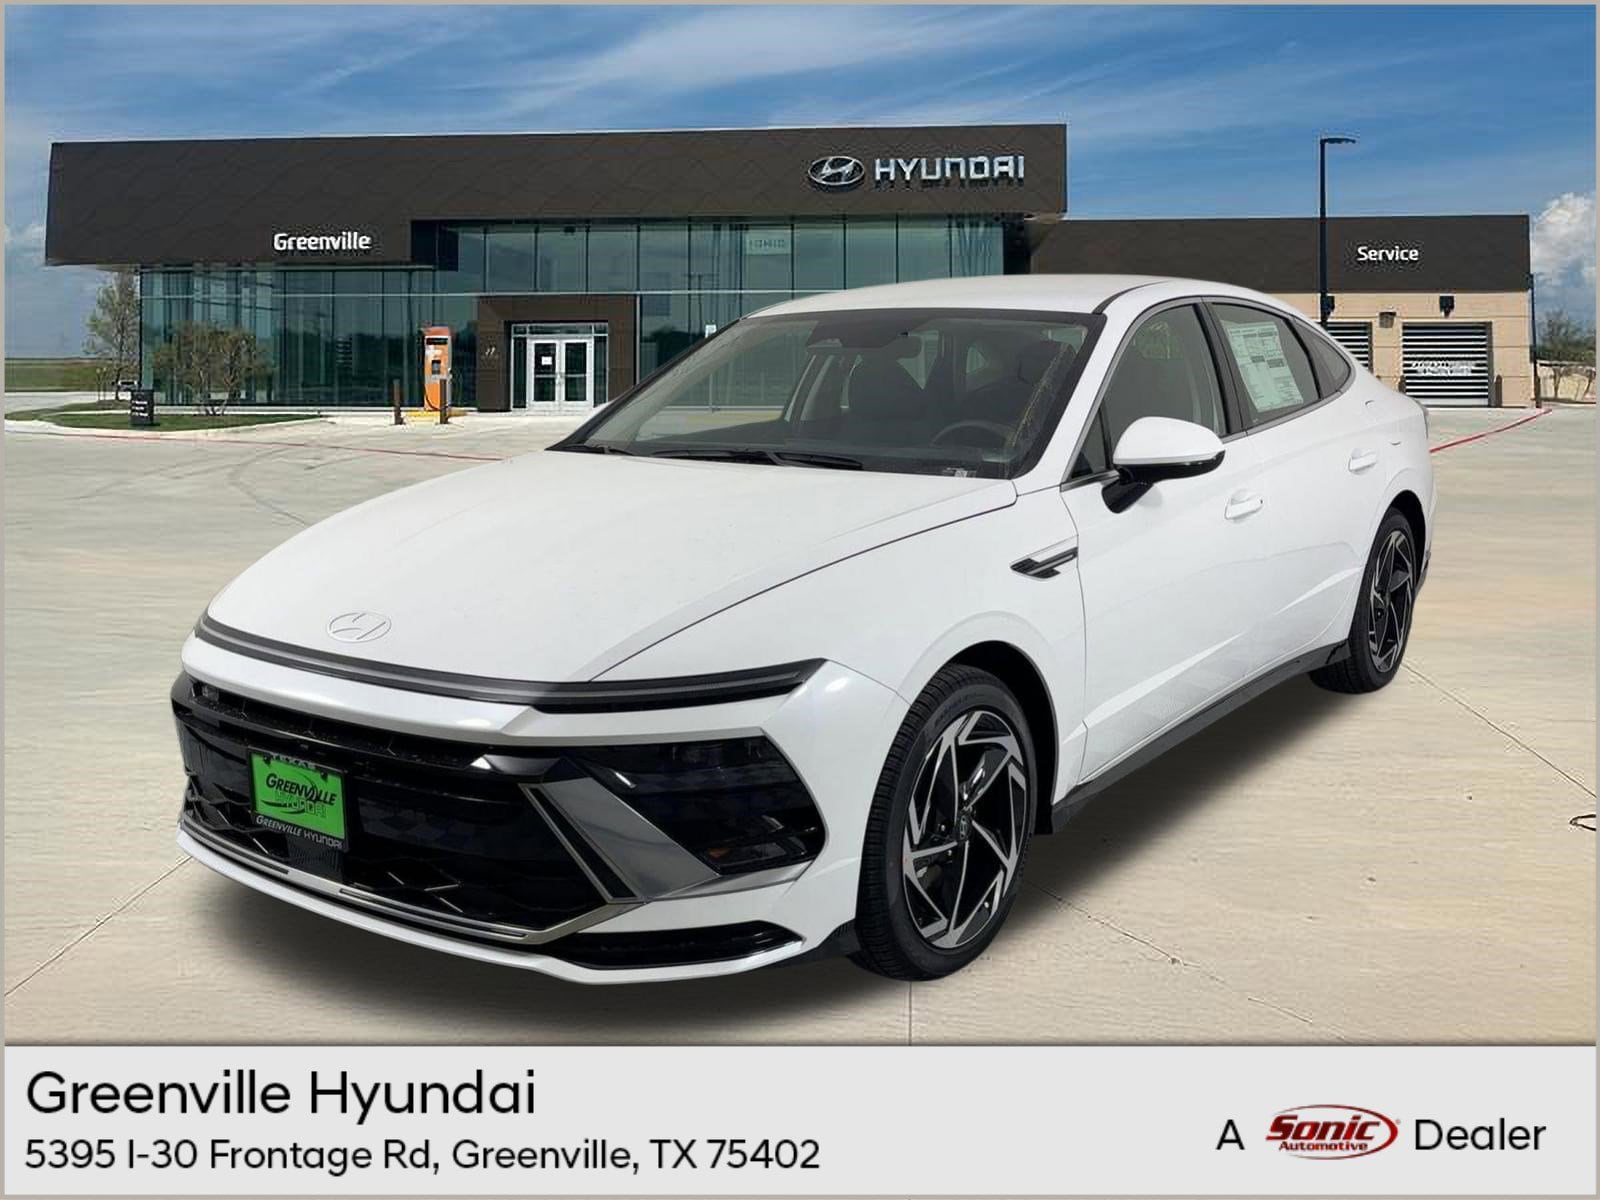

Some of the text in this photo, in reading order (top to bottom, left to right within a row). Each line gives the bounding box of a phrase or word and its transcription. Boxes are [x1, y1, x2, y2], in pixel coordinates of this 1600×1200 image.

[875, 155, 1025, 181] HYUNDAI
[273, 231, 371, 251] Greenville
[1357, 245, 1419, 261] Service
[266, 773, 337, 806] GREENVILLE
[256, 815, 343, 849] GREENVILLE HYUNDAI
